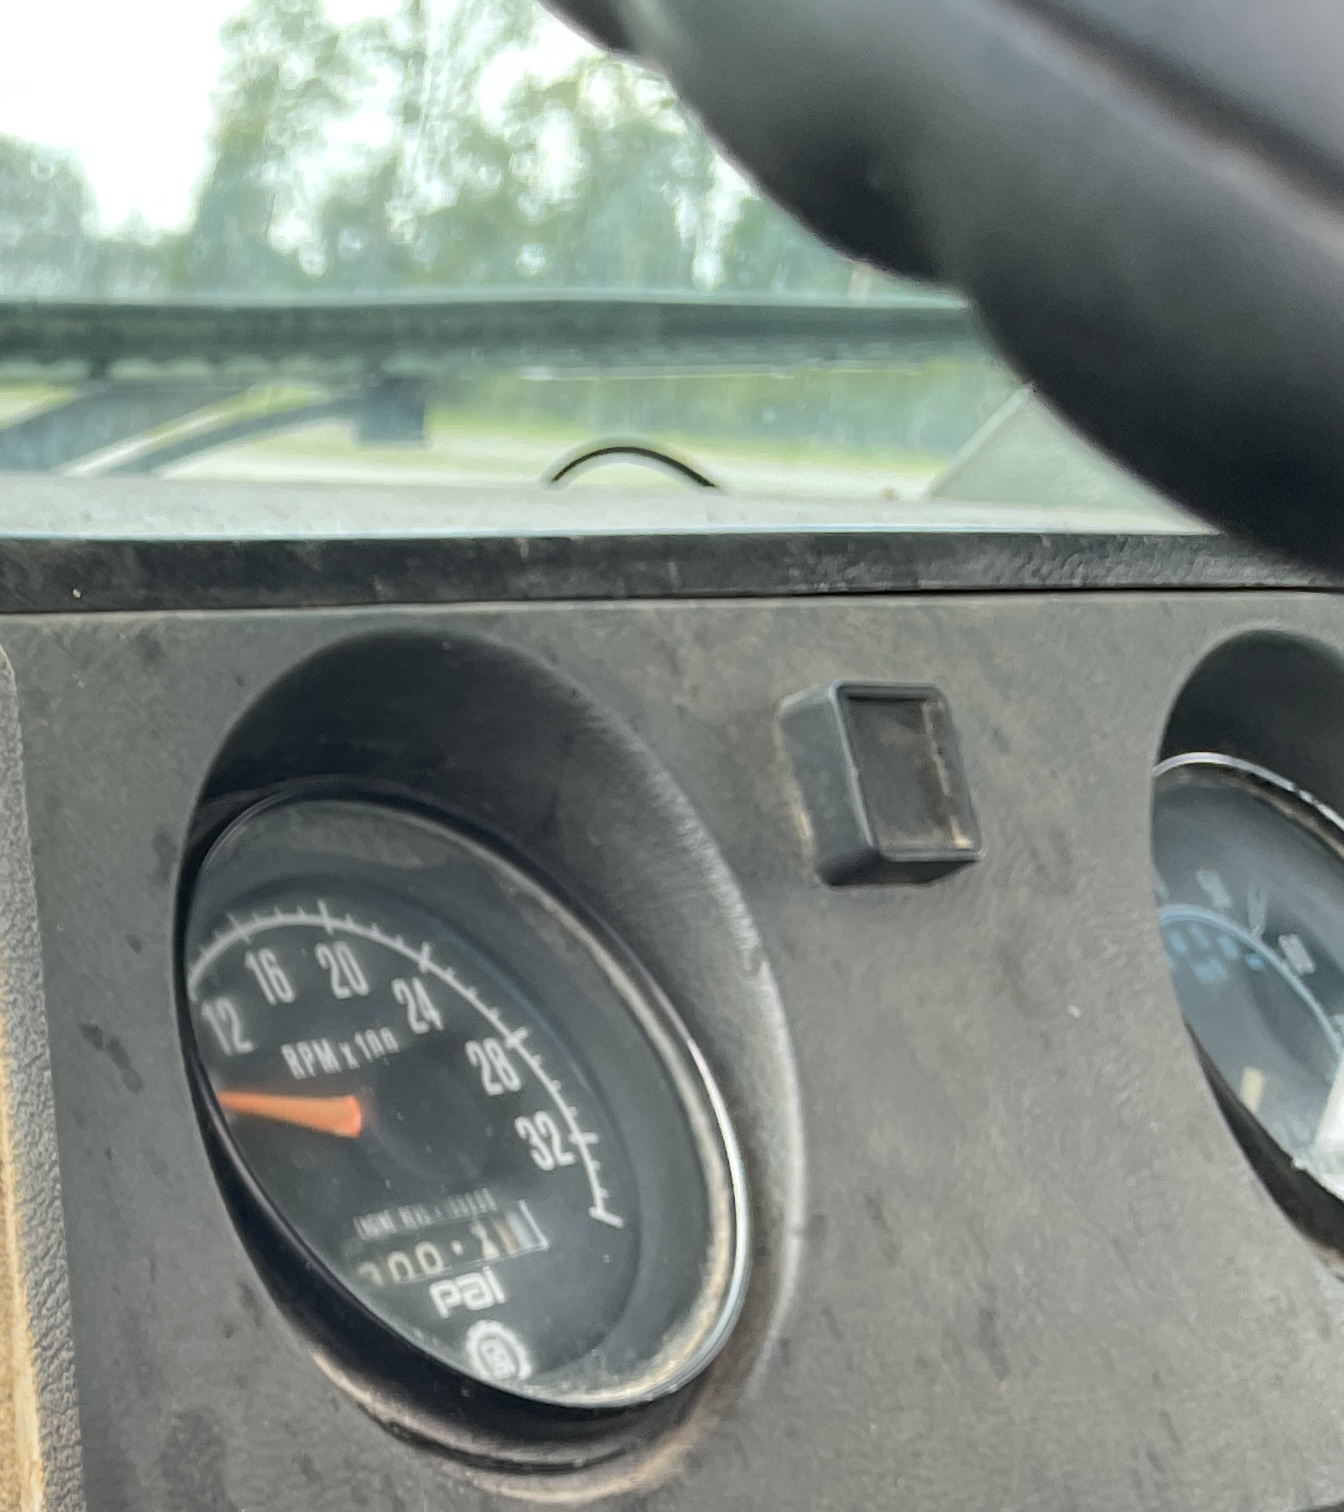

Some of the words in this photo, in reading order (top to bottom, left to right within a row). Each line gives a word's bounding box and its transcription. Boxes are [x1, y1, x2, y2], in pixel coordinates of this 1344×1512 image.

[244, 947, 295, 1004] 16
[316, 943, 370, 1000] 20
[202, 1000, 254, 1056] 12
[392, 978, 443, 1035] 24
[281, 1037, 338, 1080] RPM
[466, 1039, 520, 1096] 28
[516, 1111, 575, 1170] 32
